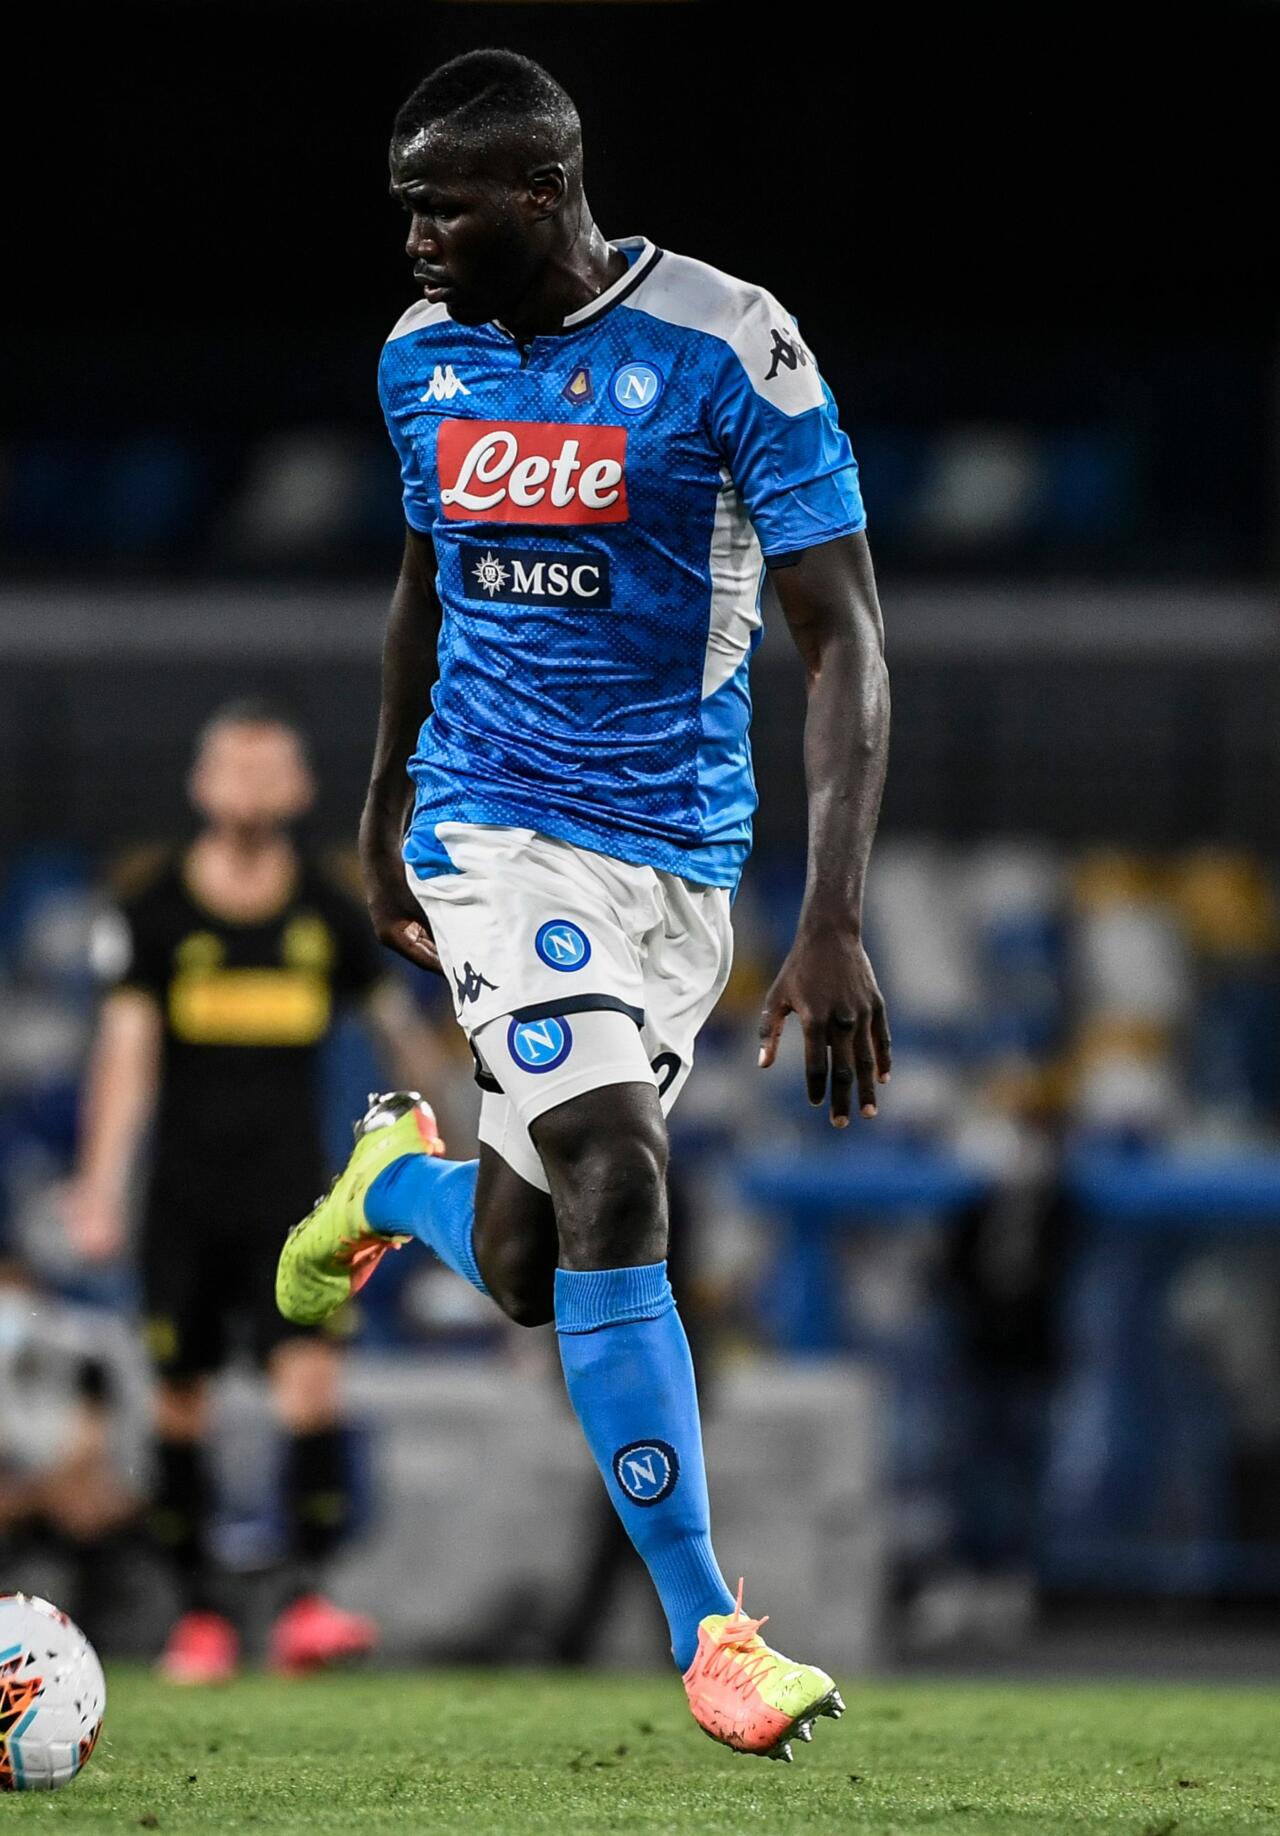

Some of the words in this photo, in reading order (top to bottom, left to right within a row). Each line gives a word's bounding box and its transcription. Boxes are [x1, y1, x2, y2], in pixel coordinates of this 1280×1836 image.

[623, 374, 651, 401] N
[440, 430, 623, 511] Lete
[510, 560, 600, 597] MSC
[548, 932, 577, 959] N
[520, 1020, 555, 1060] N
[624, 1454, 657, 1490] N
